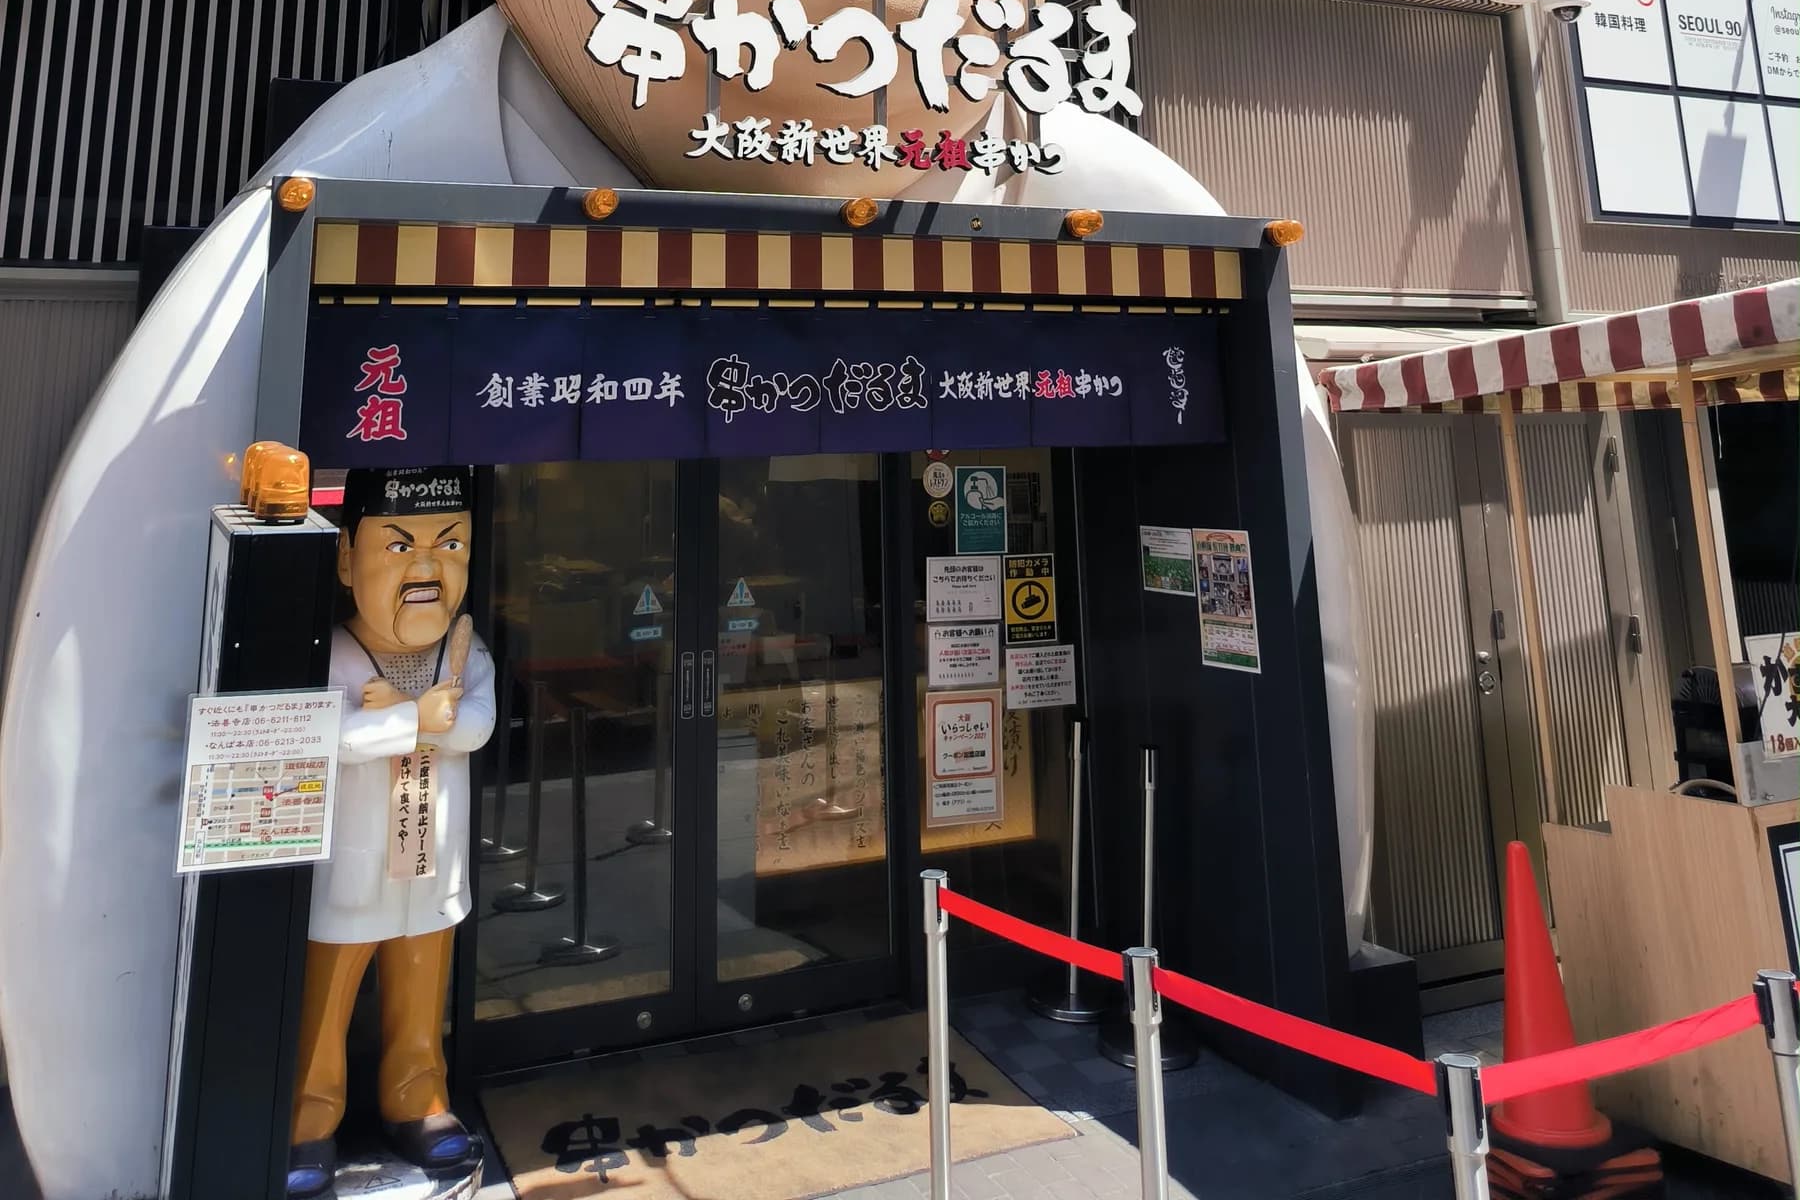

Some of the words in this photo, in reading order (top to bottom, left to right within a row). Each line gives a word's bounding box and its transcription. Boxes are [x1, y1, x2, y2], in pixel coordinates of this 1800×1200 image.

[1594, 12, 1647, 33] 韓国料理
[1678, 14, 1724, 35] SEOUL
[1724, 20, 1742, 37] 90
[686, 113, 1067, 176] 大阪新世界元祖串かつ
[346, 344, 407, 442] 元祖
[476, 371, 686, 409] 創業昭和四年
[706, 354, 928, 424] 串かつだるま
[939, 369, 1123, 400] 大阪新世界元祖串かつ
[385, 478, 462, 503] 串かつだるま
[941, 721, 989, 735] いらっしゃい
